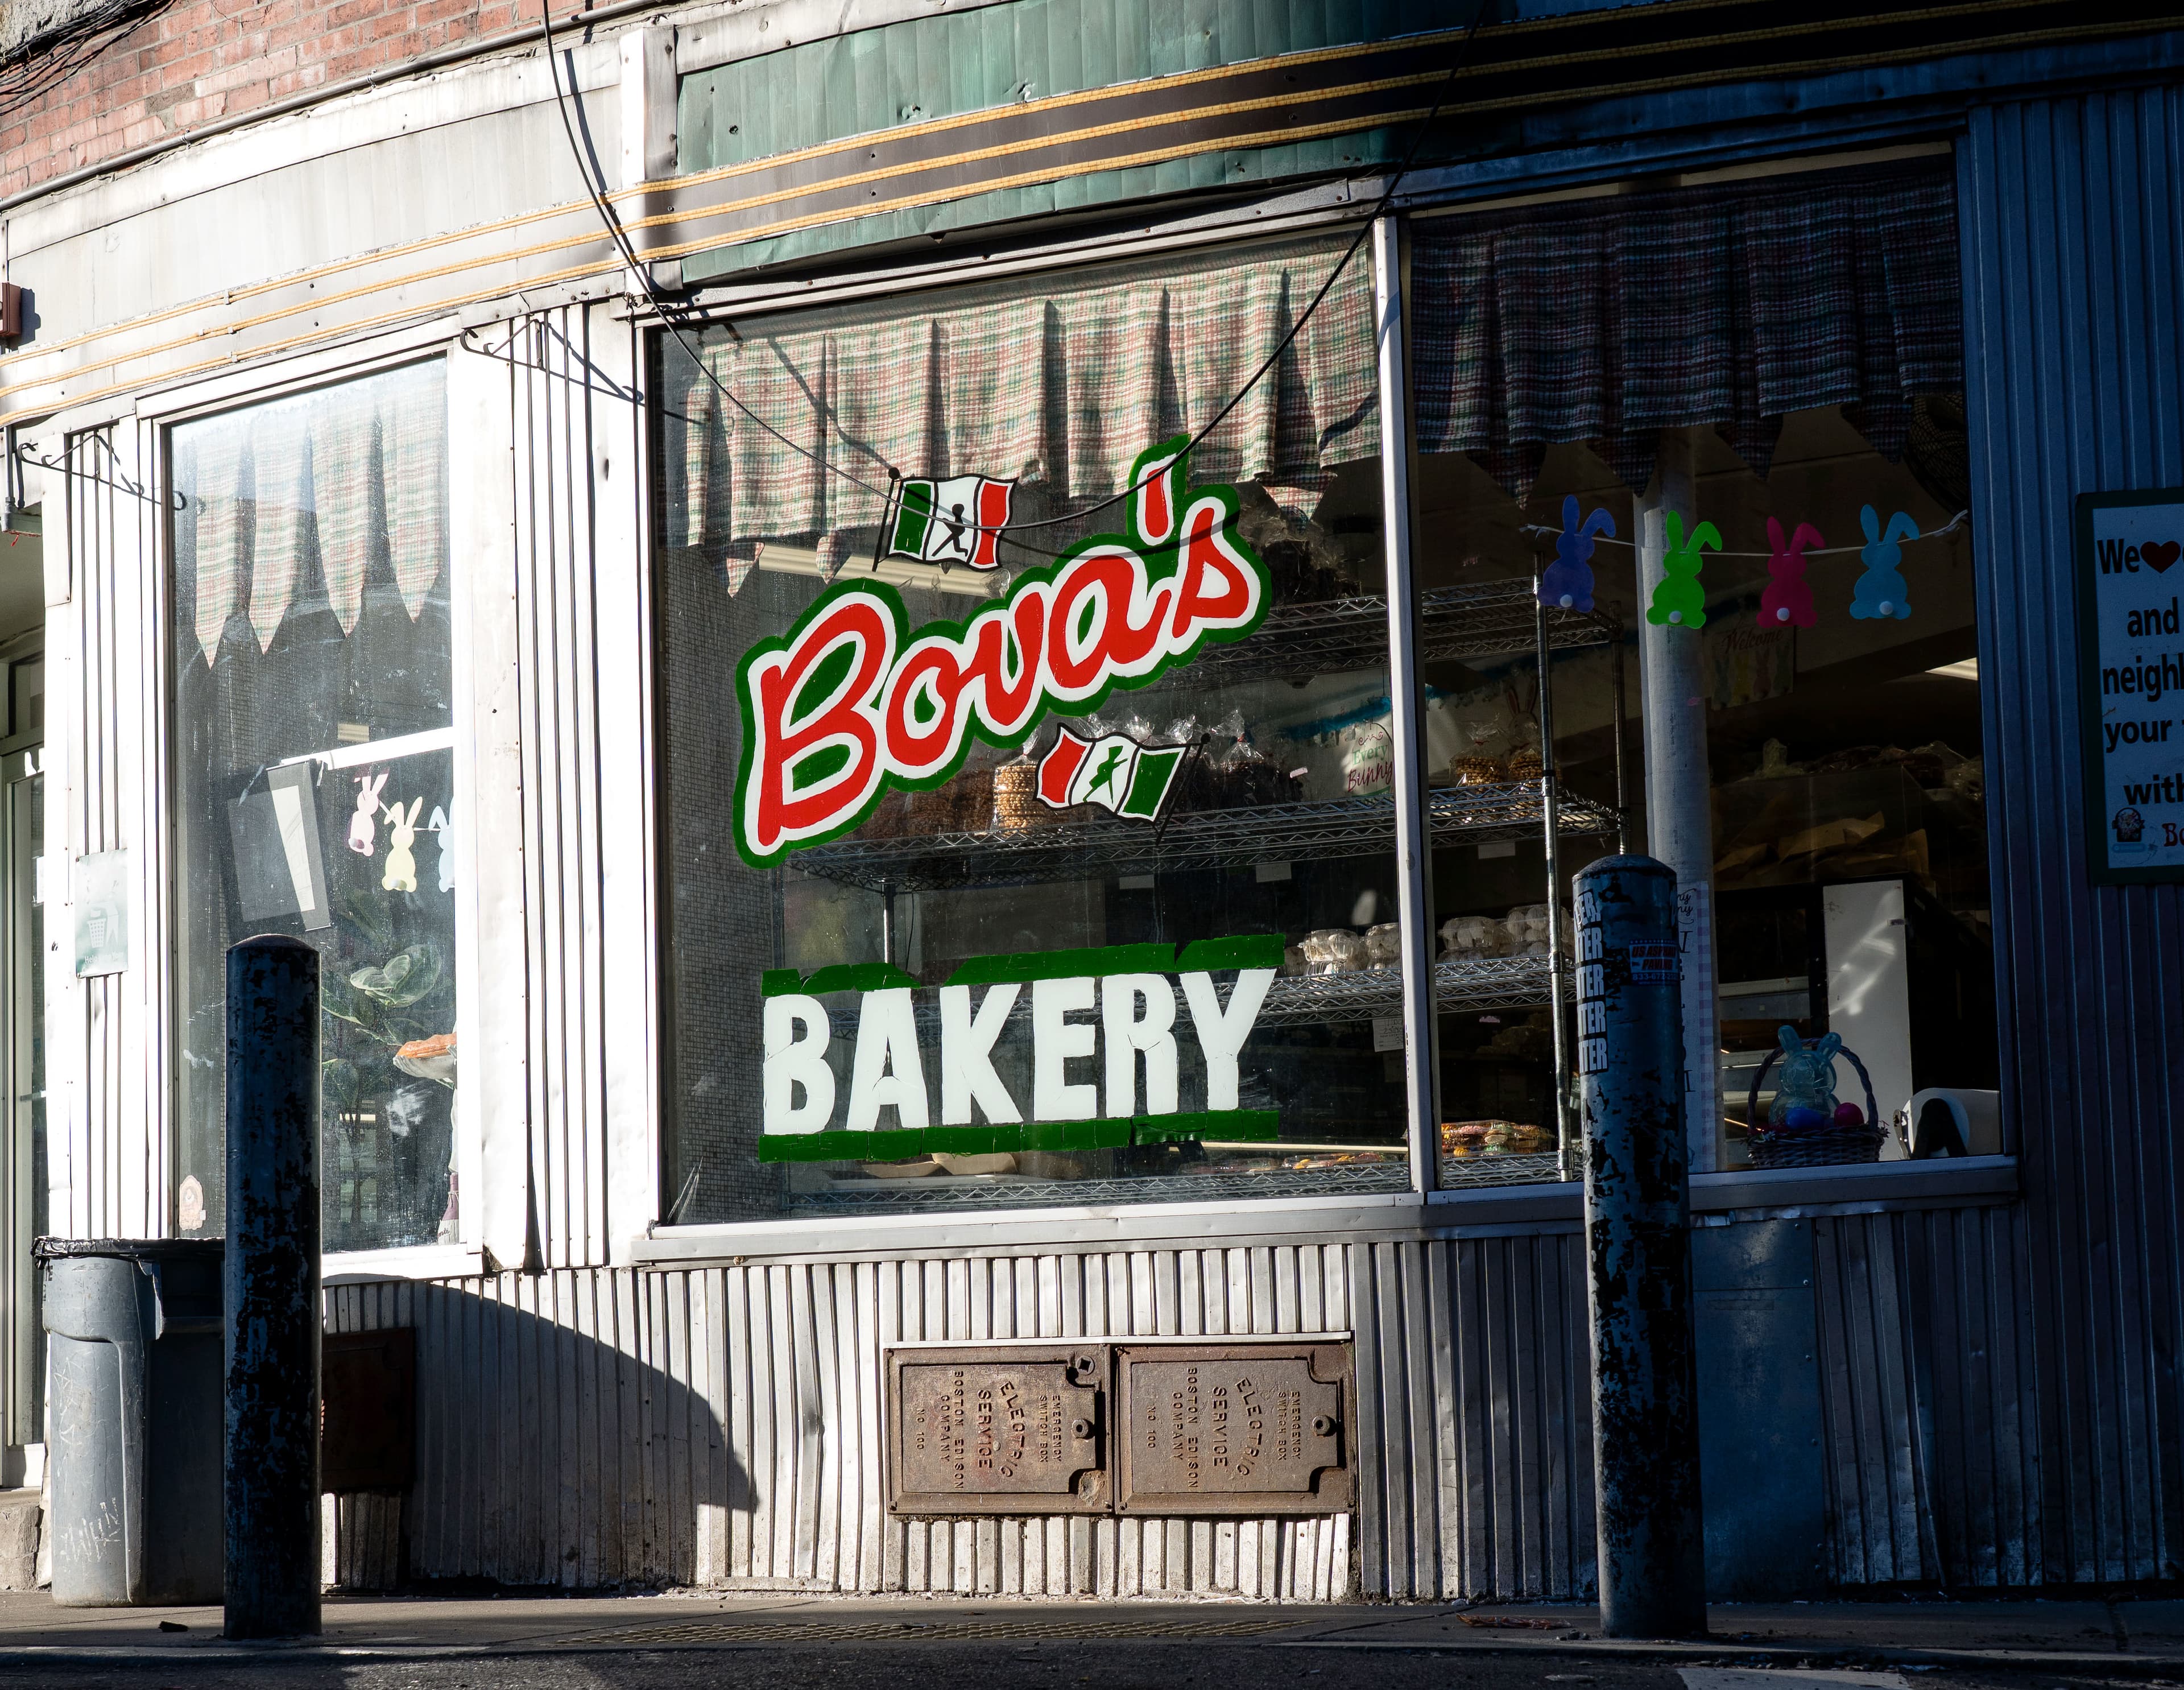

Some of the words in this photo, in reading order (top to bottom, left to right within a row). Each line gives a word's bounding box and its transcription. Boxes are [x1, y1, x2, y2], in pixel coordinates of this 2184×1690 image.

[2097, 539, 2140, 574] We
[1722, 628, 1784, 654] Welcome
[2128, 597, 2179, 637] and
[747, 453, 1260, 856] Bova's
[1352, 745, 1388, 765] Every
[2104, 720, 2173, 753] your
[1348, 762, 1393, 792] Bunny
[763, 968, 1277, 1135] BAKERY
[916, 1409, 925, 1423] NO
[954, 1370, 964, 1426] BOSTON
[1039, 1395, 1048, 1436] SWITCH
[1147, 1406, 1156, 1421] NO
[1187, 1367, 1198, 1424] BOSTON
[1278, 1391, 1287, 1434] SWITCH
[916, 1432, 925, 1450] 100
[940, 1395, 950, 1462] COMPANY
[978, 1389, 992, 1469] SERVICE
[999, 1381, 1025, 1477] ELECTRIC
[1052, 1395, 1061, 1462] EMERGENCY
[1147, 1430, 1156, 1449] 100
[1172, 1392, 1183, 1461] COMPANY
[1213, 1387, 1227, 1467] SERVICE
[1235, 1377, 1263, 1476] ELECTRIC
[1278, 1440, 1287, 1461] BOX
[1291, 1391, 1301, 1460] EMERGENCY
[954, 1439, 964, 1489] EDISON
[1188, 1436, 1198, 1488] EDISON
